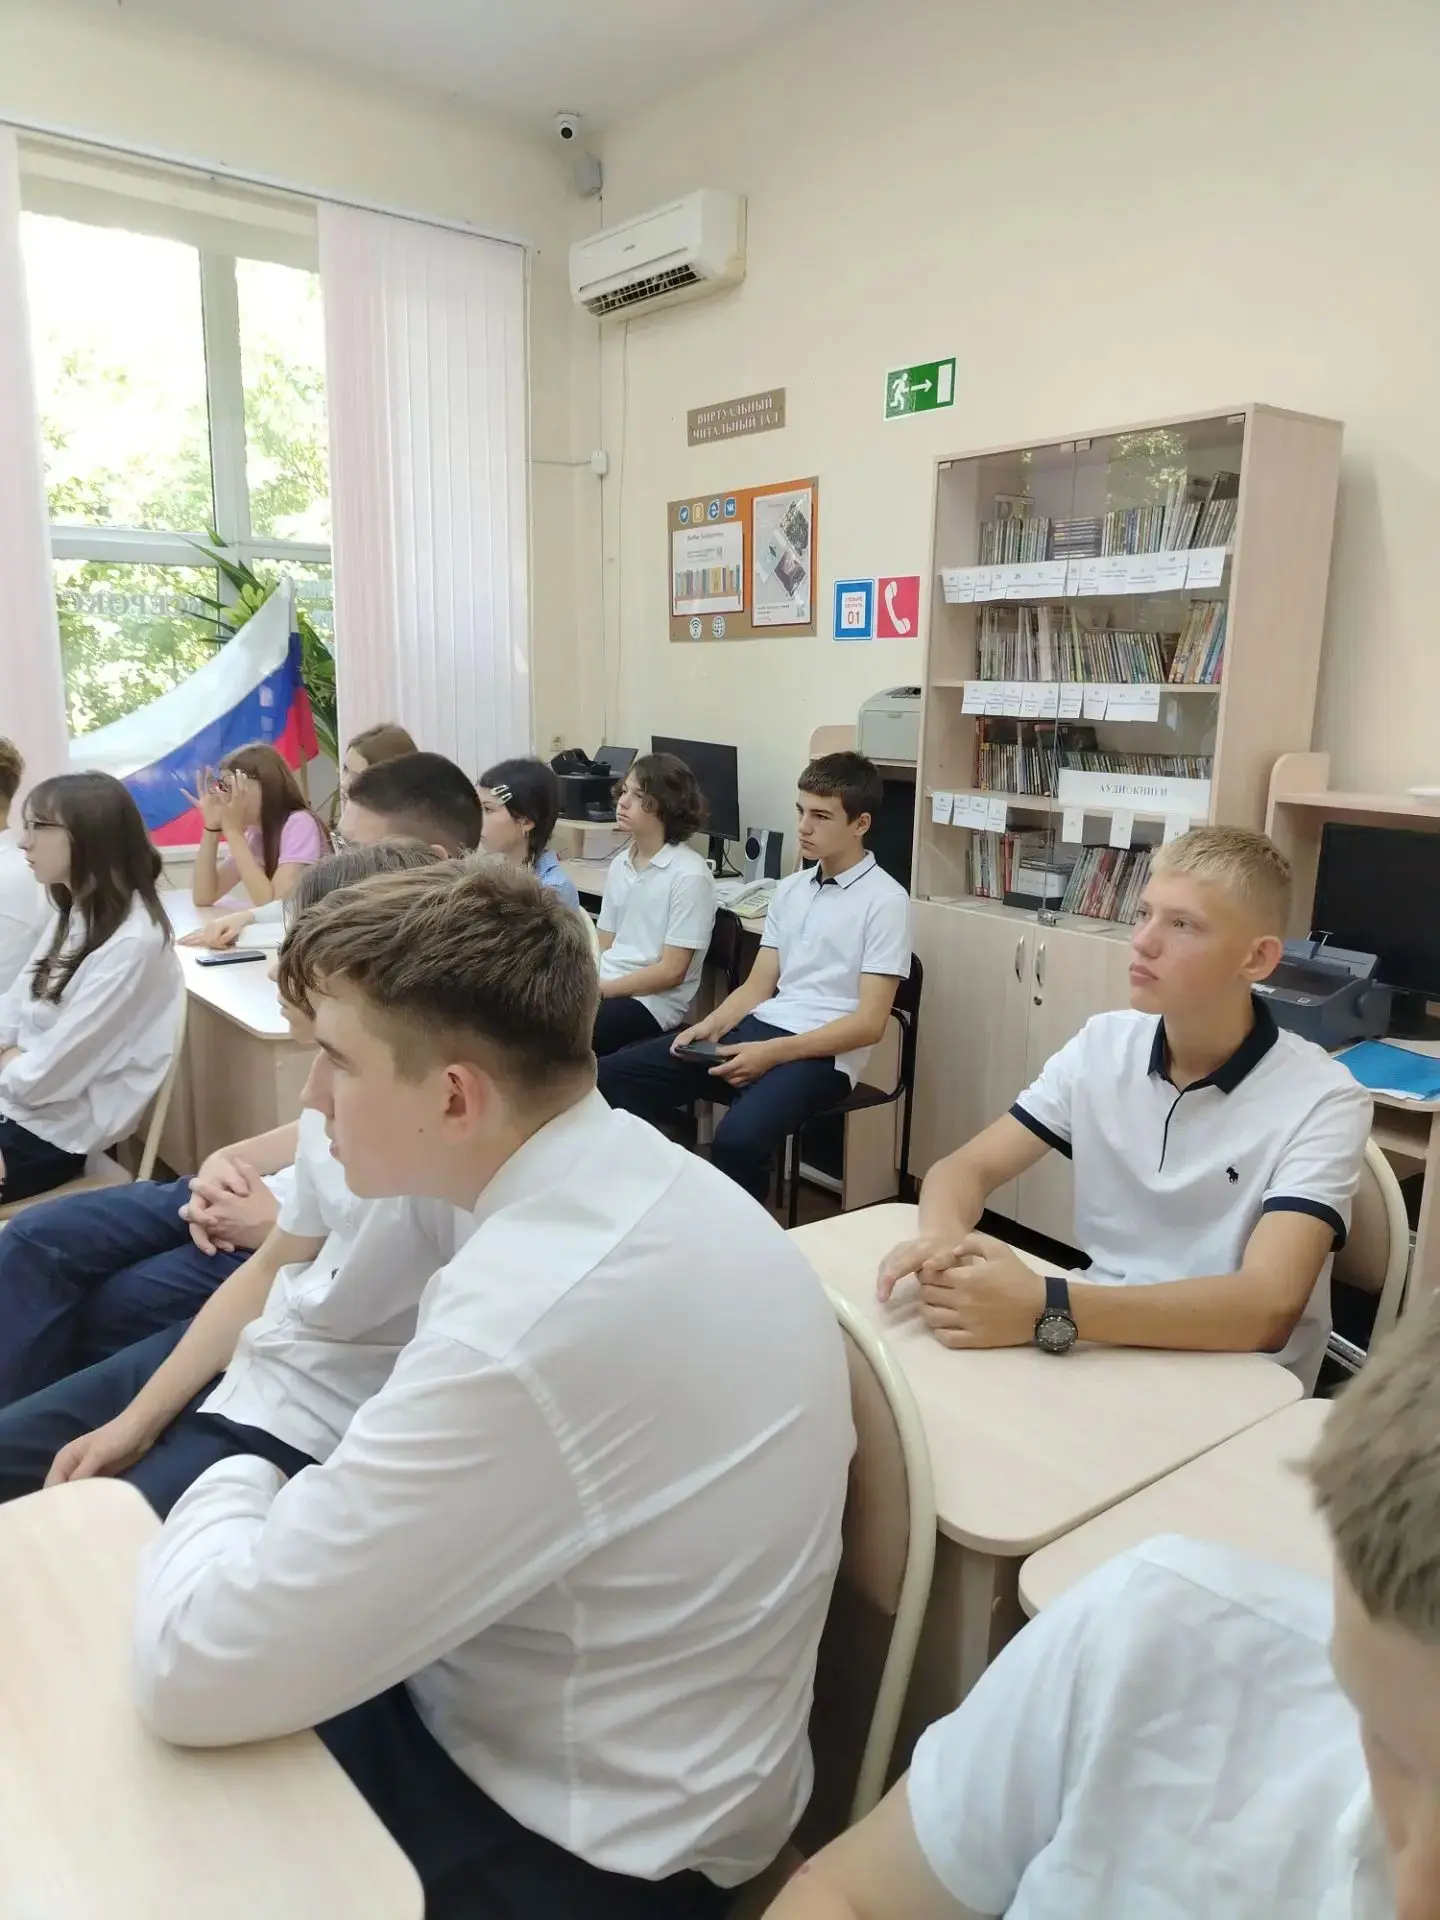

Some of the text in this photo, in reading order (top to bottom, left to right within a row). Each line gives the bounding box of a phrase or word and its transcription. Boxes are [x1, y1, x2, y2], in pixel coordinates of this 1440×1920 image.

[697, 394, 773, 424] ВИРТУАЛЬНЫЙ
[693, 413, 756, 439] ЧИТАЛЬНЫЙ
[848, 611, 859, 624] 01
[1098, 784, 1168, 797] АУДИОКНИГИ
